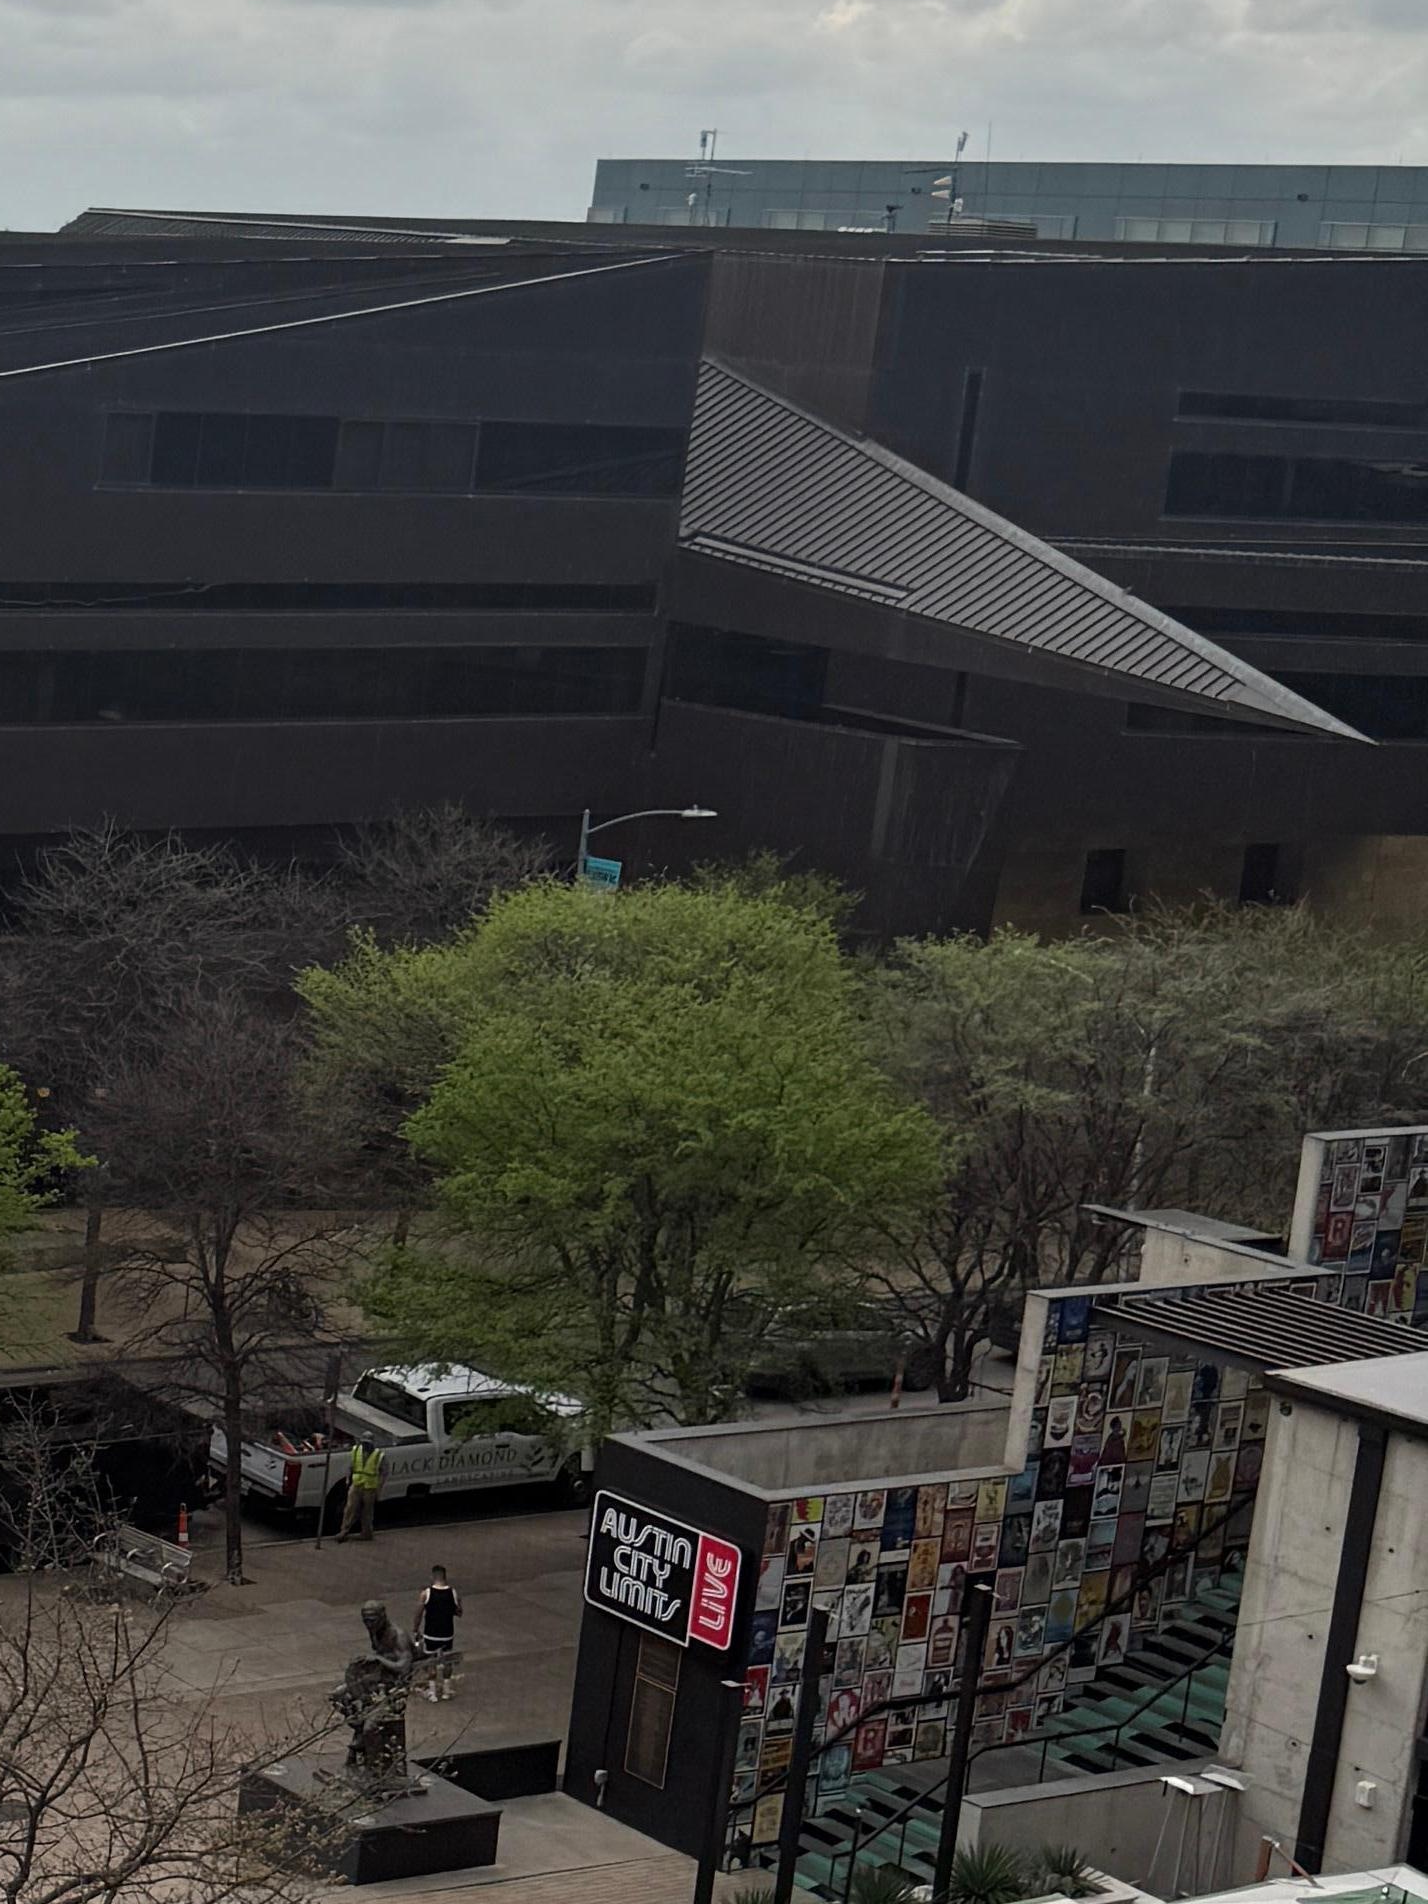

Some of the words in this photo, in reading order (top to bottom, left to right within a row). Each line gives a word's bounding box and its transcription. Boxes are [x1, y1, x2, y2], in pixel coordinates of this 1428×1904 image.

[391, 1457, 433, 1476] LACK
[439, 1448, 517, 1471] DIAMOND
[600, 1507, 693, 1570] AUSTIN
[613, 1545, 672, 1589] CITY
[599, 1567, 682, 1622] LIMITS
